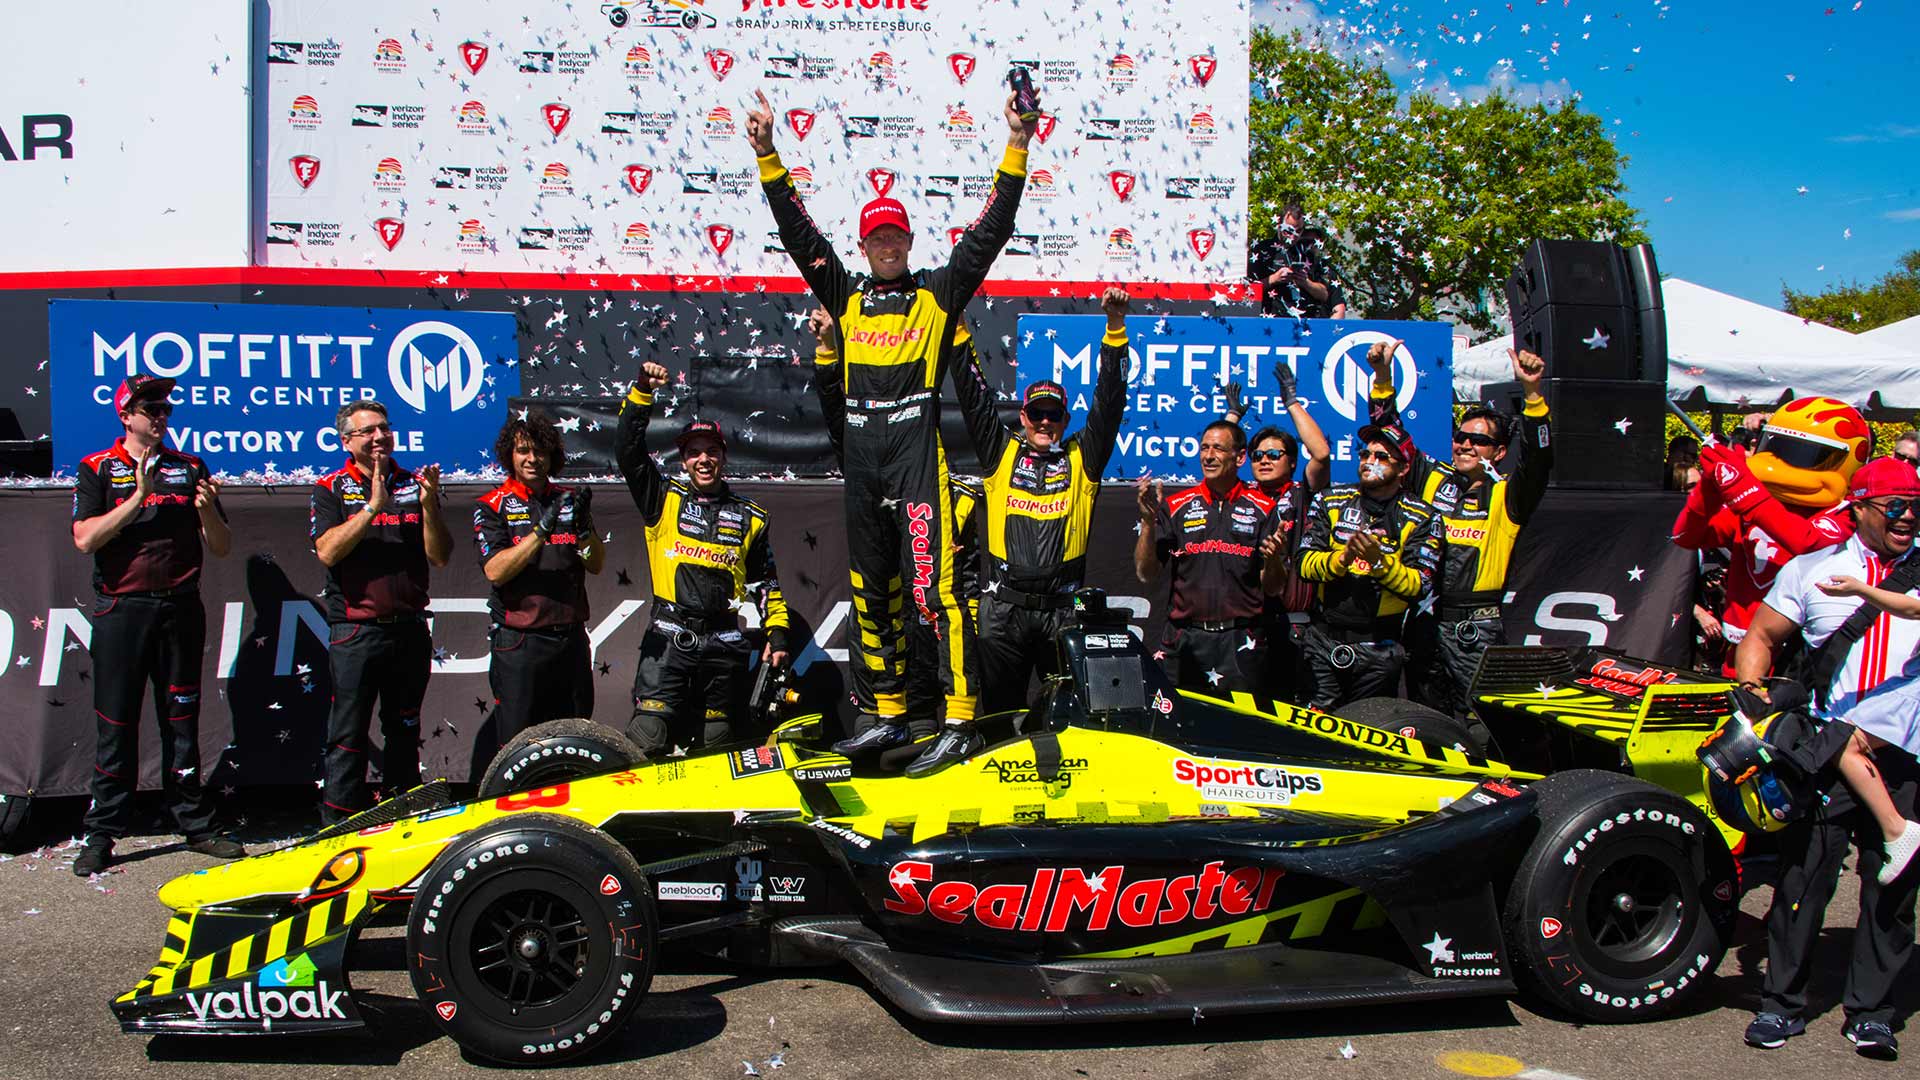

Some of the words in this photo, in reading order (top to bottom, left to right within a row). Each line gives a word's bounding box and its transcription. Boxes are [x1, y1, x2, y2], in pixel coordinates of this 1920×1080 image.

[307, 50, 341, 59] indycar
[558, 51, 590, 59] verizon
[558, 59, 591, 67] indycar
[1043, 59, 1075, 67] verizon
[558, 67, 585, 75] series
[1044, 67, 1076, 75] indycar
[391, 104, 424, 112] verizon
[392, 113, 425, 122] indycar
[883, 115, 914, 123] verizon
[1124, 118, 1155, 126] verizon
[883, 123, 915, 132] indycar
[475, 174, 508, 183] indycar
[963, 175, 994, 183] verizon
[306, 221, 340, 230] verizon
[307, 229, 341, 238] indycar
[1043, 249, 1069, 257] series
[93, 331, 374, 379] MOFFITT
[93, 385, 231, 405] CCER
[168, 427, 304, 453] VICTORY
[316, 426, 425, 452] CLE
[1116, 431, 1200, 458] VICTO
[1006, 495, 1070, 514] SealMaster
[673, 541, 740, 567] SealMaster
[1184, 540, 1256, 557] SealMaster
[1286, 704, 1415, 756] HONDA
[503, 744, 602, 782] Firestone
[983, 757, 1089, 771] Amean
[999, 769, 1071, 790] Racg
[1206, 786, 1287, 802] HAIRCUTS
[809, 819, 871, 850] Firestone
[1563, 807, 1696, 867] Firestone
[422, 842, 529, 935] Firestone
[660, 884, 711, 895] oneblood
[884, 860, 1287, 933] SealMaster
[1461, 951, 1494, 960] verizon
[1433, 967, 1502, 978] Firestone
[1579, 953, 1710, 1009] Firestone
[185, 980, 346, 1021] valpak
[522, 972, 634, 1055] Firestone
